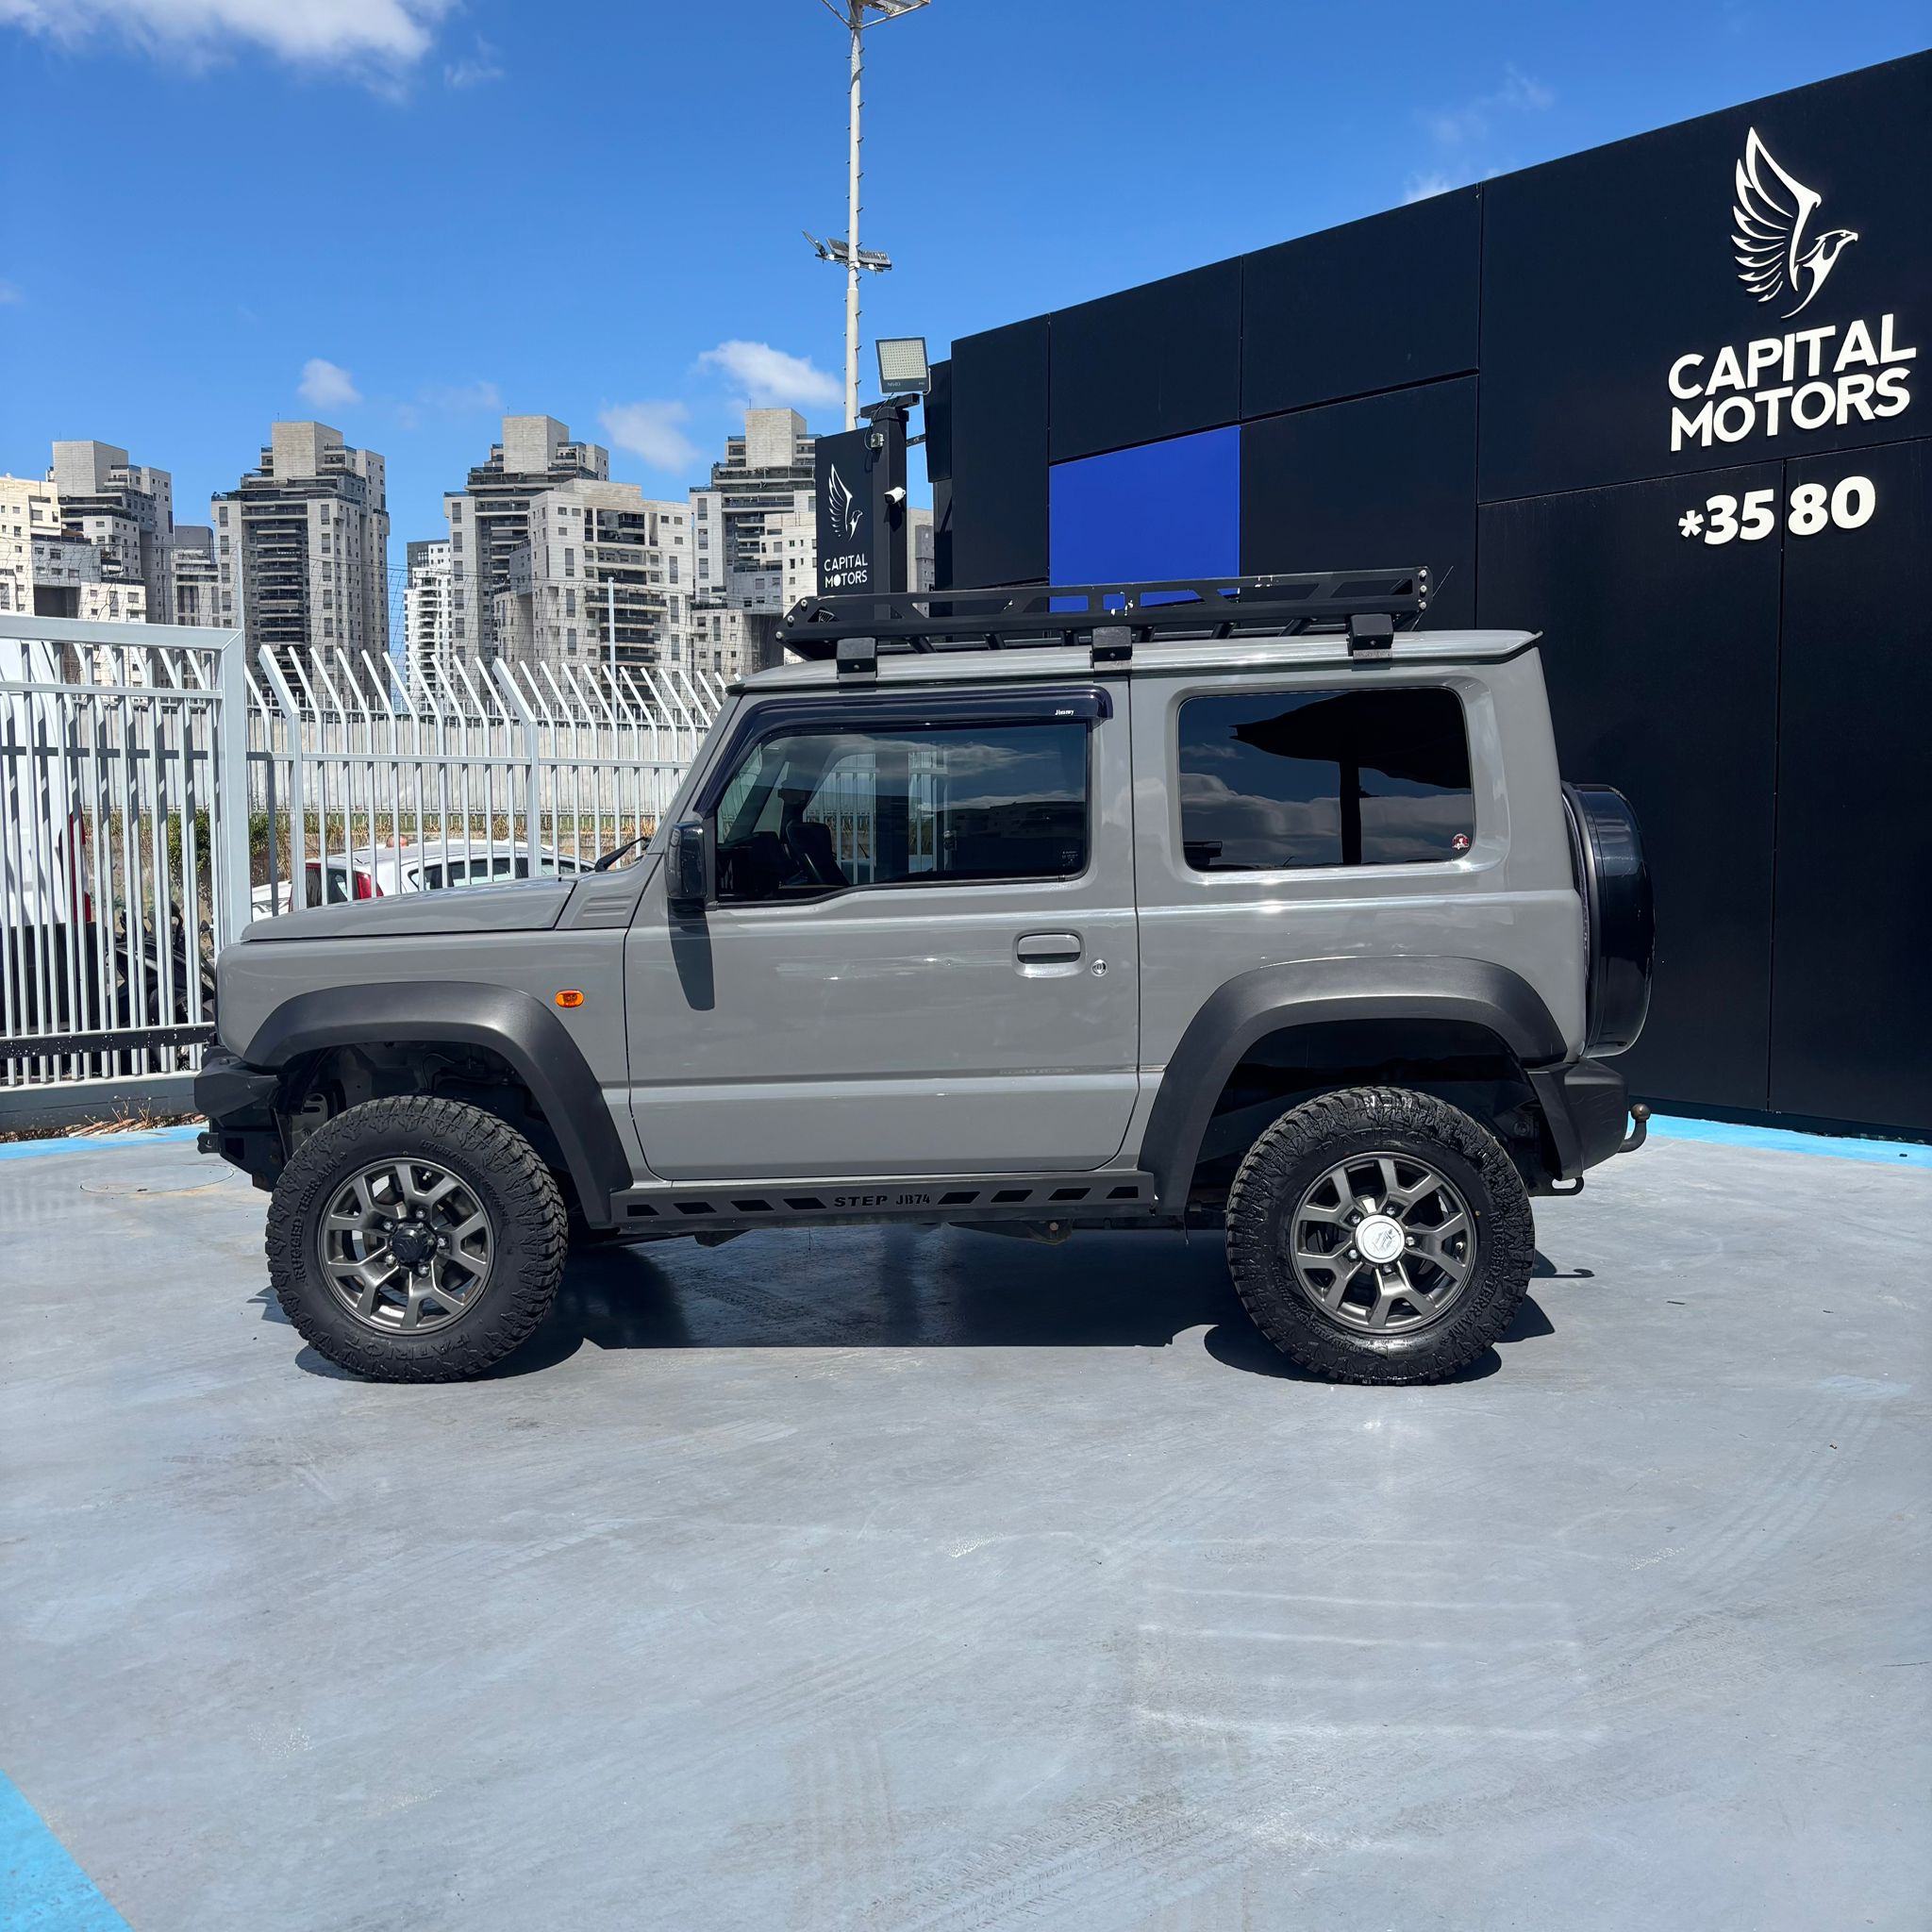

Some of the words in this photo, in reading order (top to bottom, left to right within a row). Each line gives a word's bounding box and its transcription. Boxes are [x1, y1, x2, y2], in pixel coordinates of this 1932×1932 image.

[1668, 313, 1917, 400] CAPITAL
[1670, 367, 1911, 452] MOTORS
[824, 553, 869, 572] CAPITAL
[824, 569, 868, 588] MOTORS
[833, 1194, 889, 1208] STEP
[895, 1193, 931, 1206] JB74
